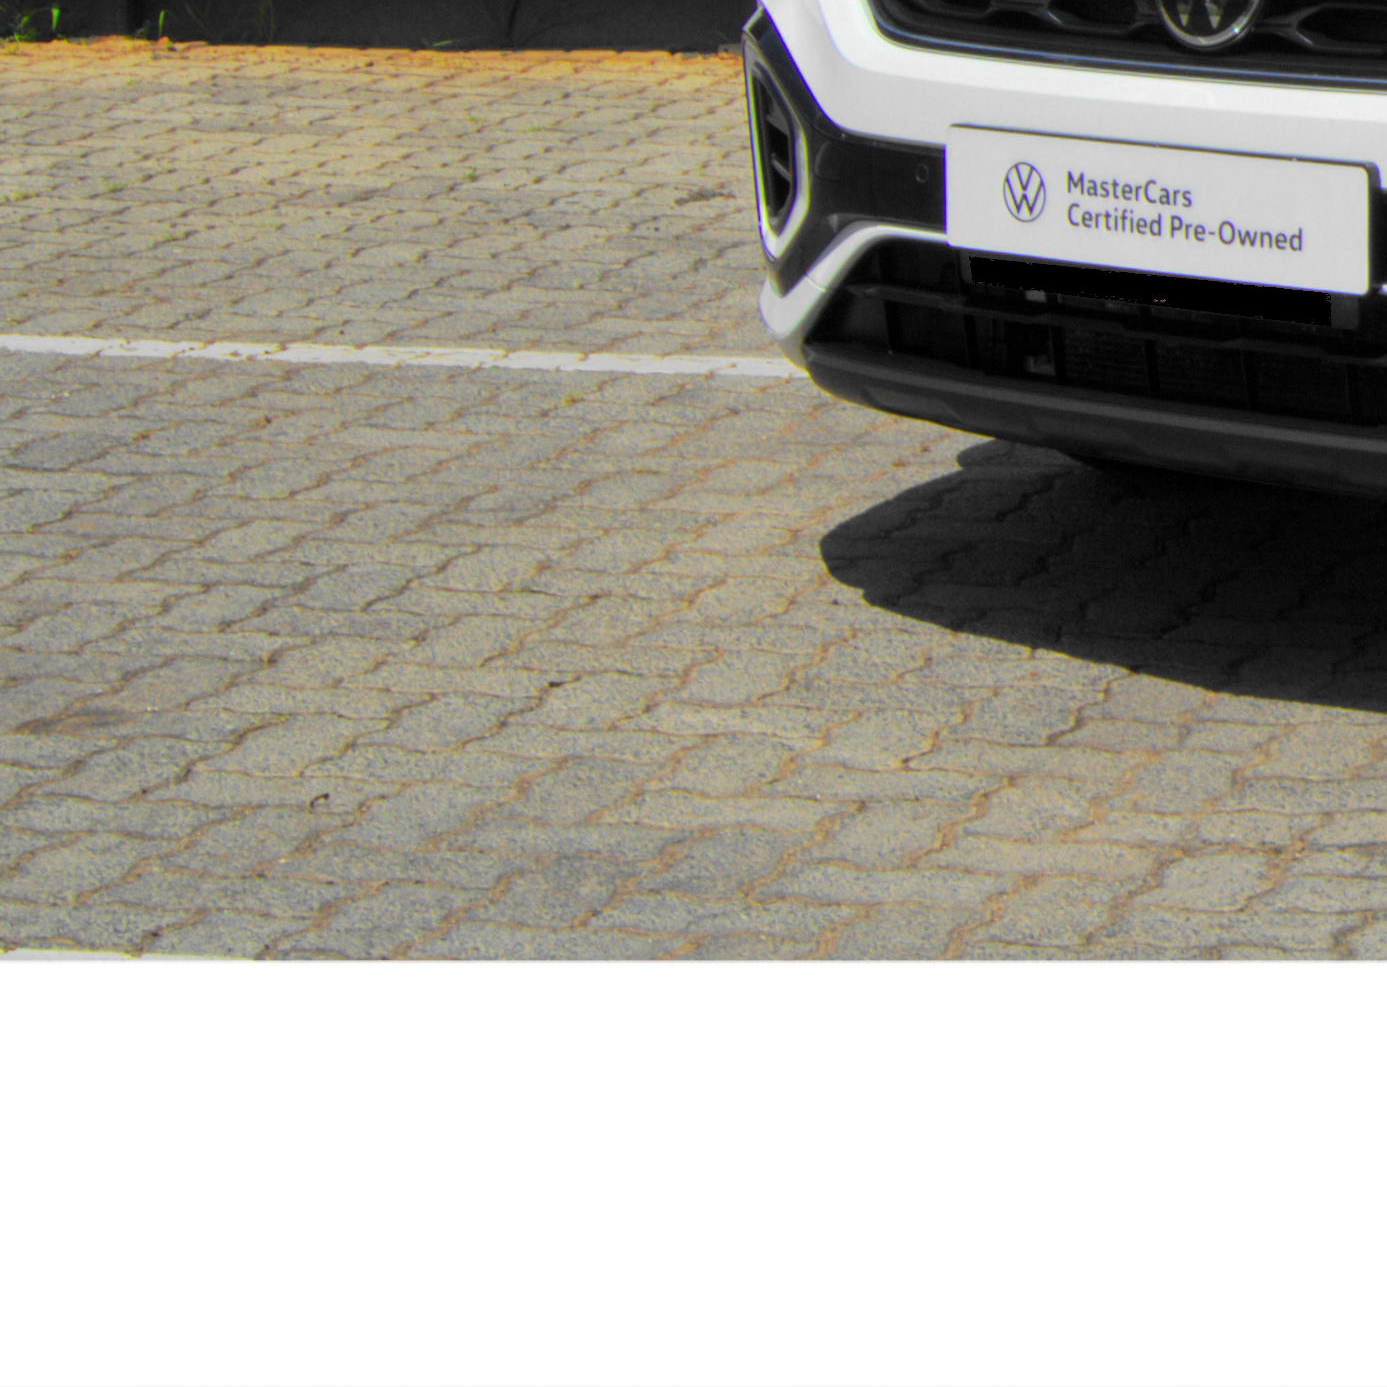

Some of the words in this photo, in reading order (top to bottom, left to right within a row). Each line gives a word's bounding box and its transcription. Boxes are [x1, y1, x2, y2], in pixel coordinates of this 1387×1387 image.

[1066, 170, 1193, 208] MasterCars
[1066, 202, 1163, 237] Certified
[1170, 215, 1303, 251] Pre-Owned
